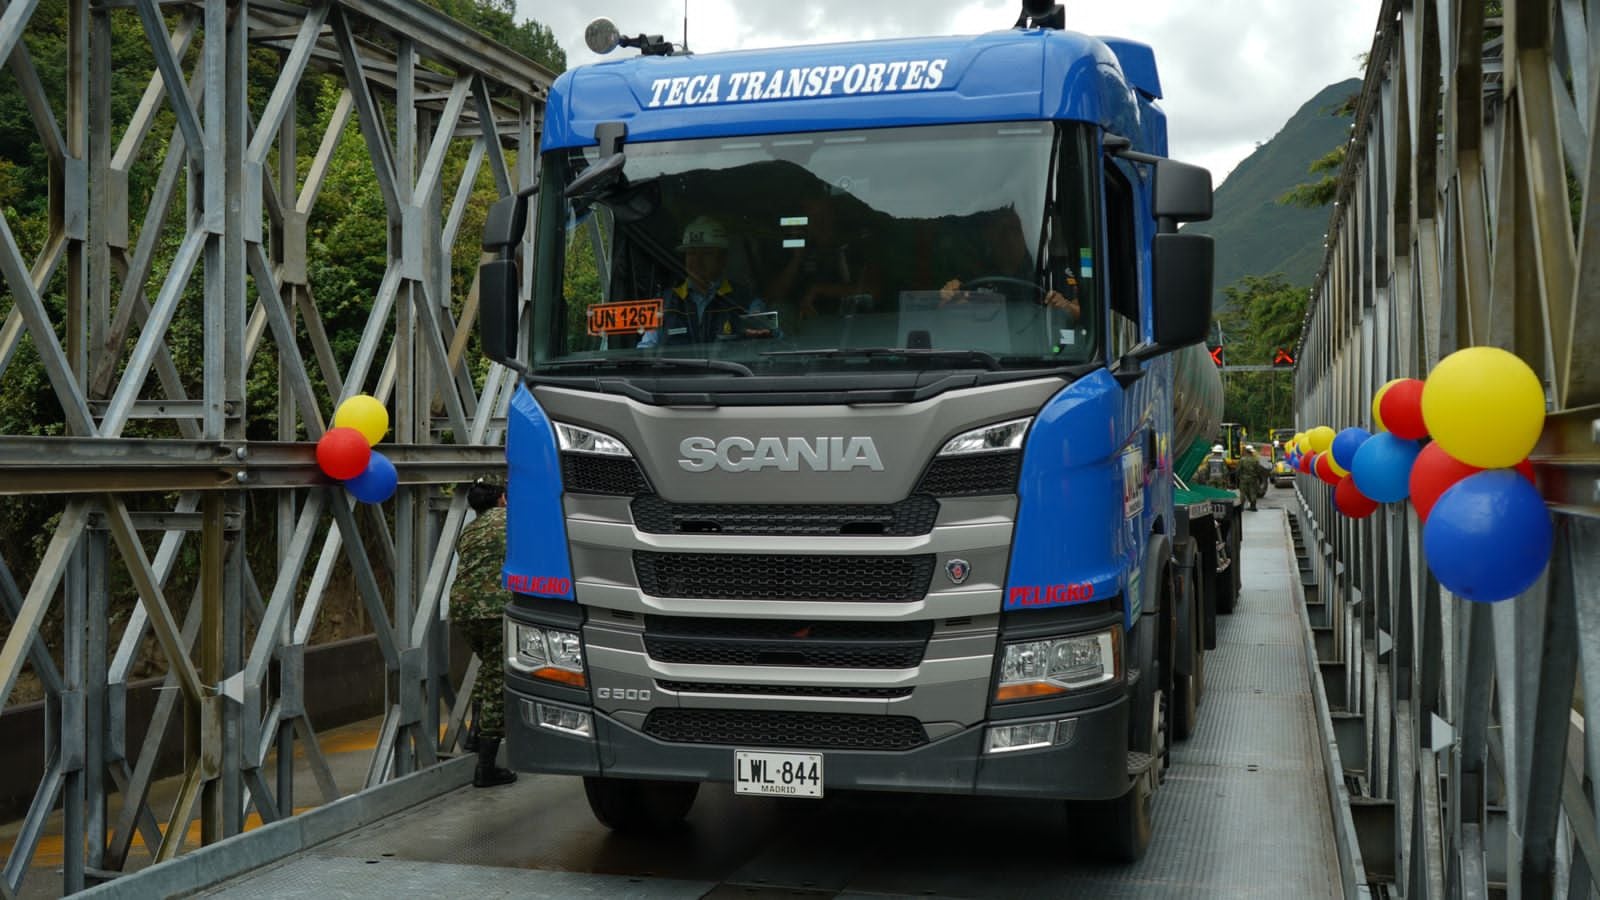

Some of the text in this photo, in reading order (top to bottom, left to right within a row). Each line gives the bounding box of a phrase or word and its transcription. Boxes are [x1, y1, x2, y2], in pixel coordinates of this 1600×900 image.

[648, 58, 948, 107] TECA TRANSPORTES
[594, 304, 657, 329] UN 1267
[678, 436, 885, 472] SCANIA
[507, 575, 570, 595] PELIGRO
[1009, 582, 1095, 605] PELIGRO
[761, 784, 796, 794] MADRID
